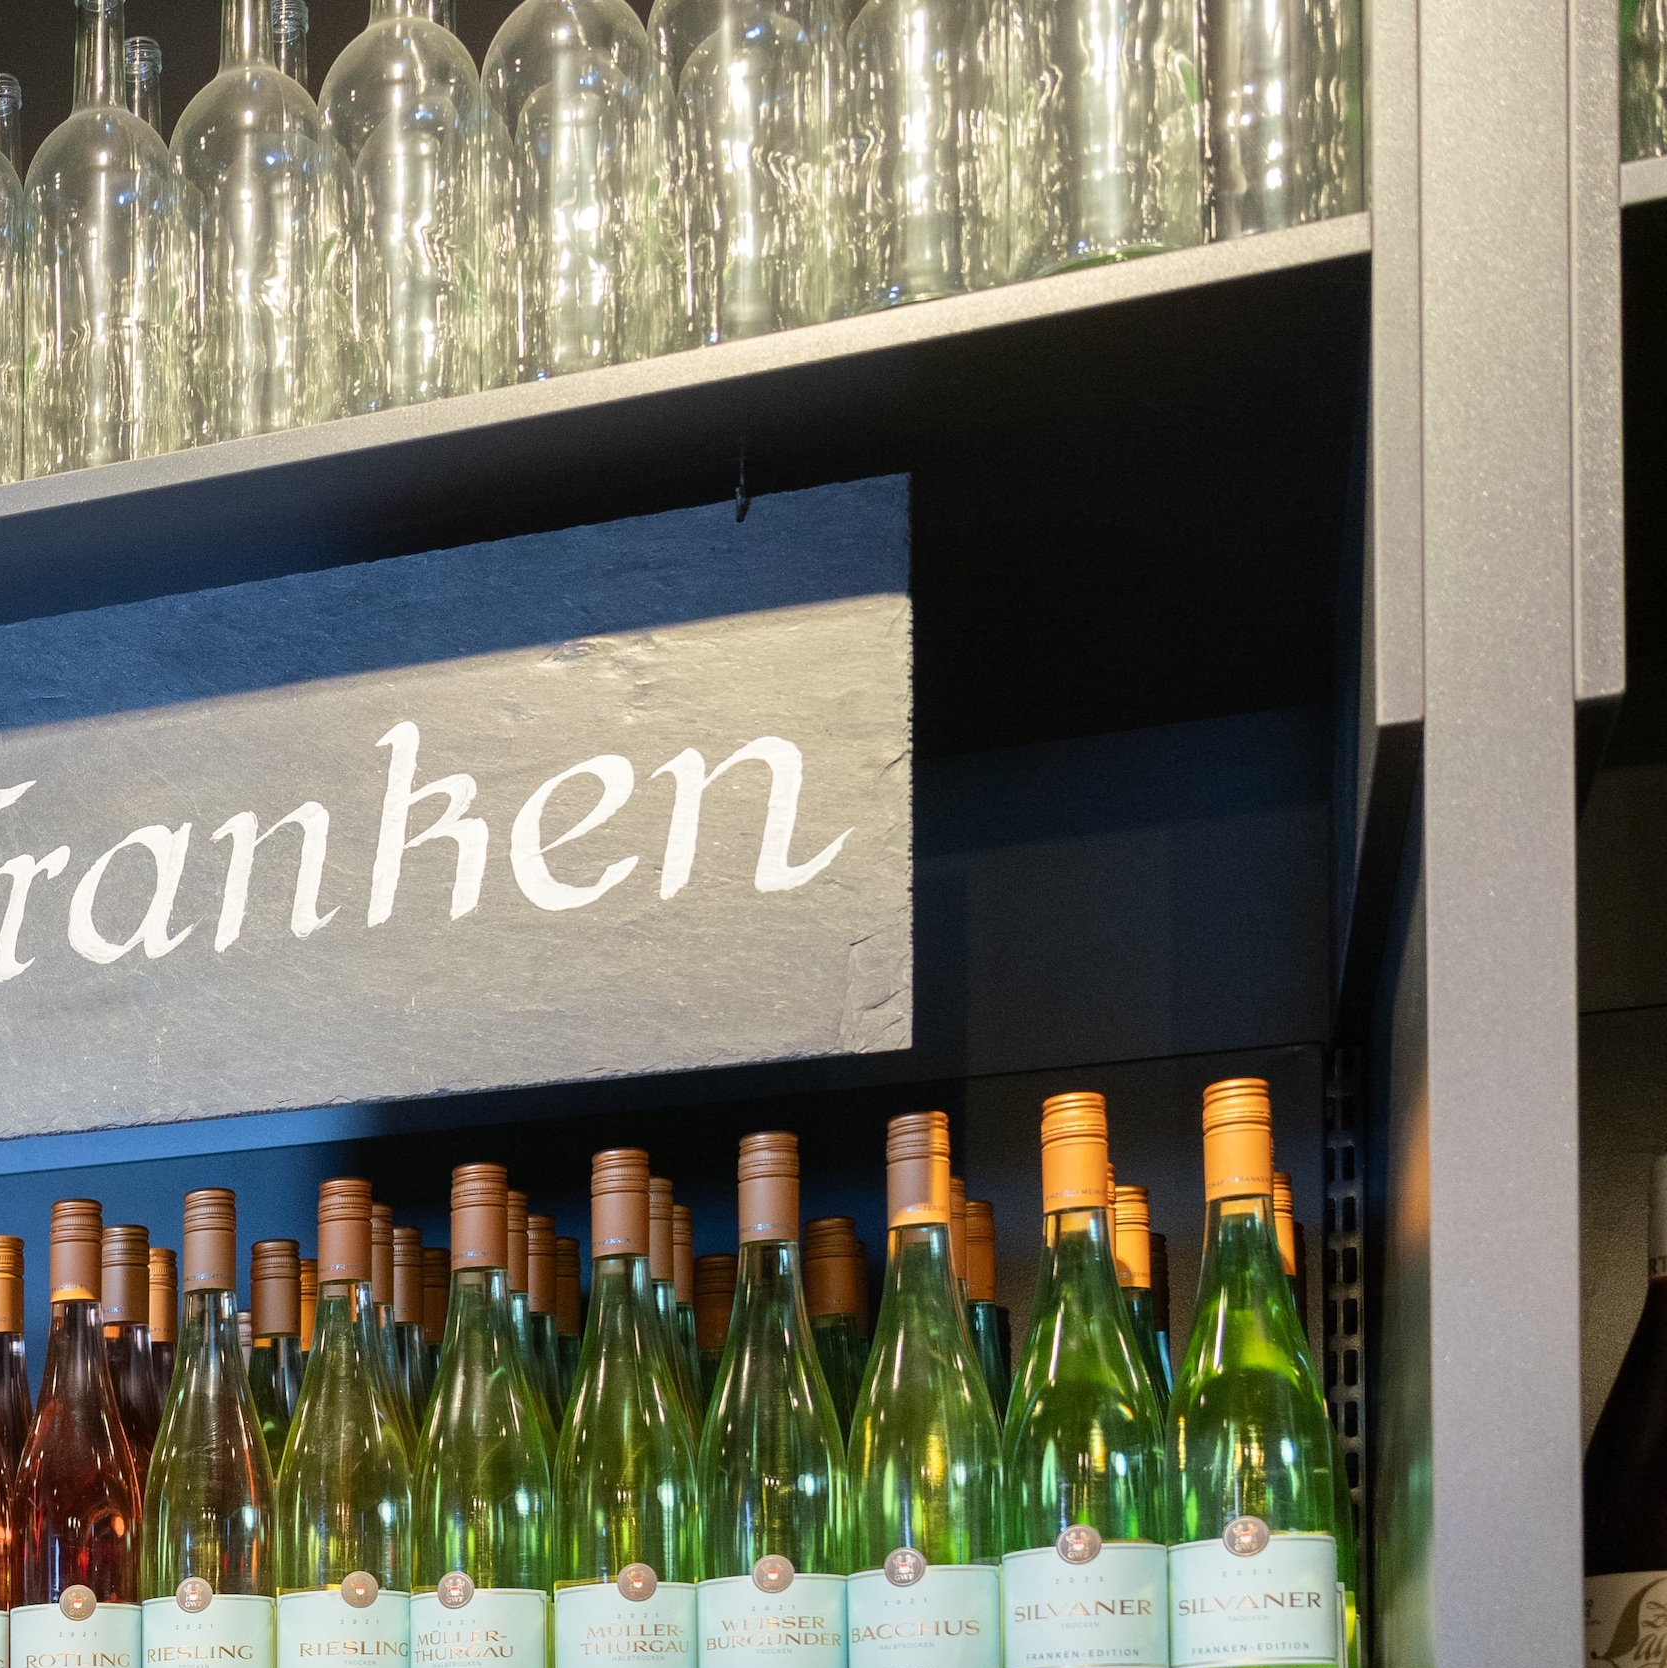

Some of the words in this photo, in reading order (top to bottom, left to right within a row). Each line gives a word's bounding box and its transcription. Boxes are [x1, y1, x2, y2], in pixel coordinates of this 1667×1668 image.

[1015, 1596, 1152, 1622] SILVANER
[1178, 1590, 1321, 1615] SILVANER
[721, 1615, 826, 1632] WEISSER
[852, 1619, 980, 1643] BACCHUS
[706, 1631, 841, 1650] BURGUNDER
[1191, 1642, 1310, 1655] FRANKEN-EDITION
[147, 1643, 254, 1662] RIESLING
